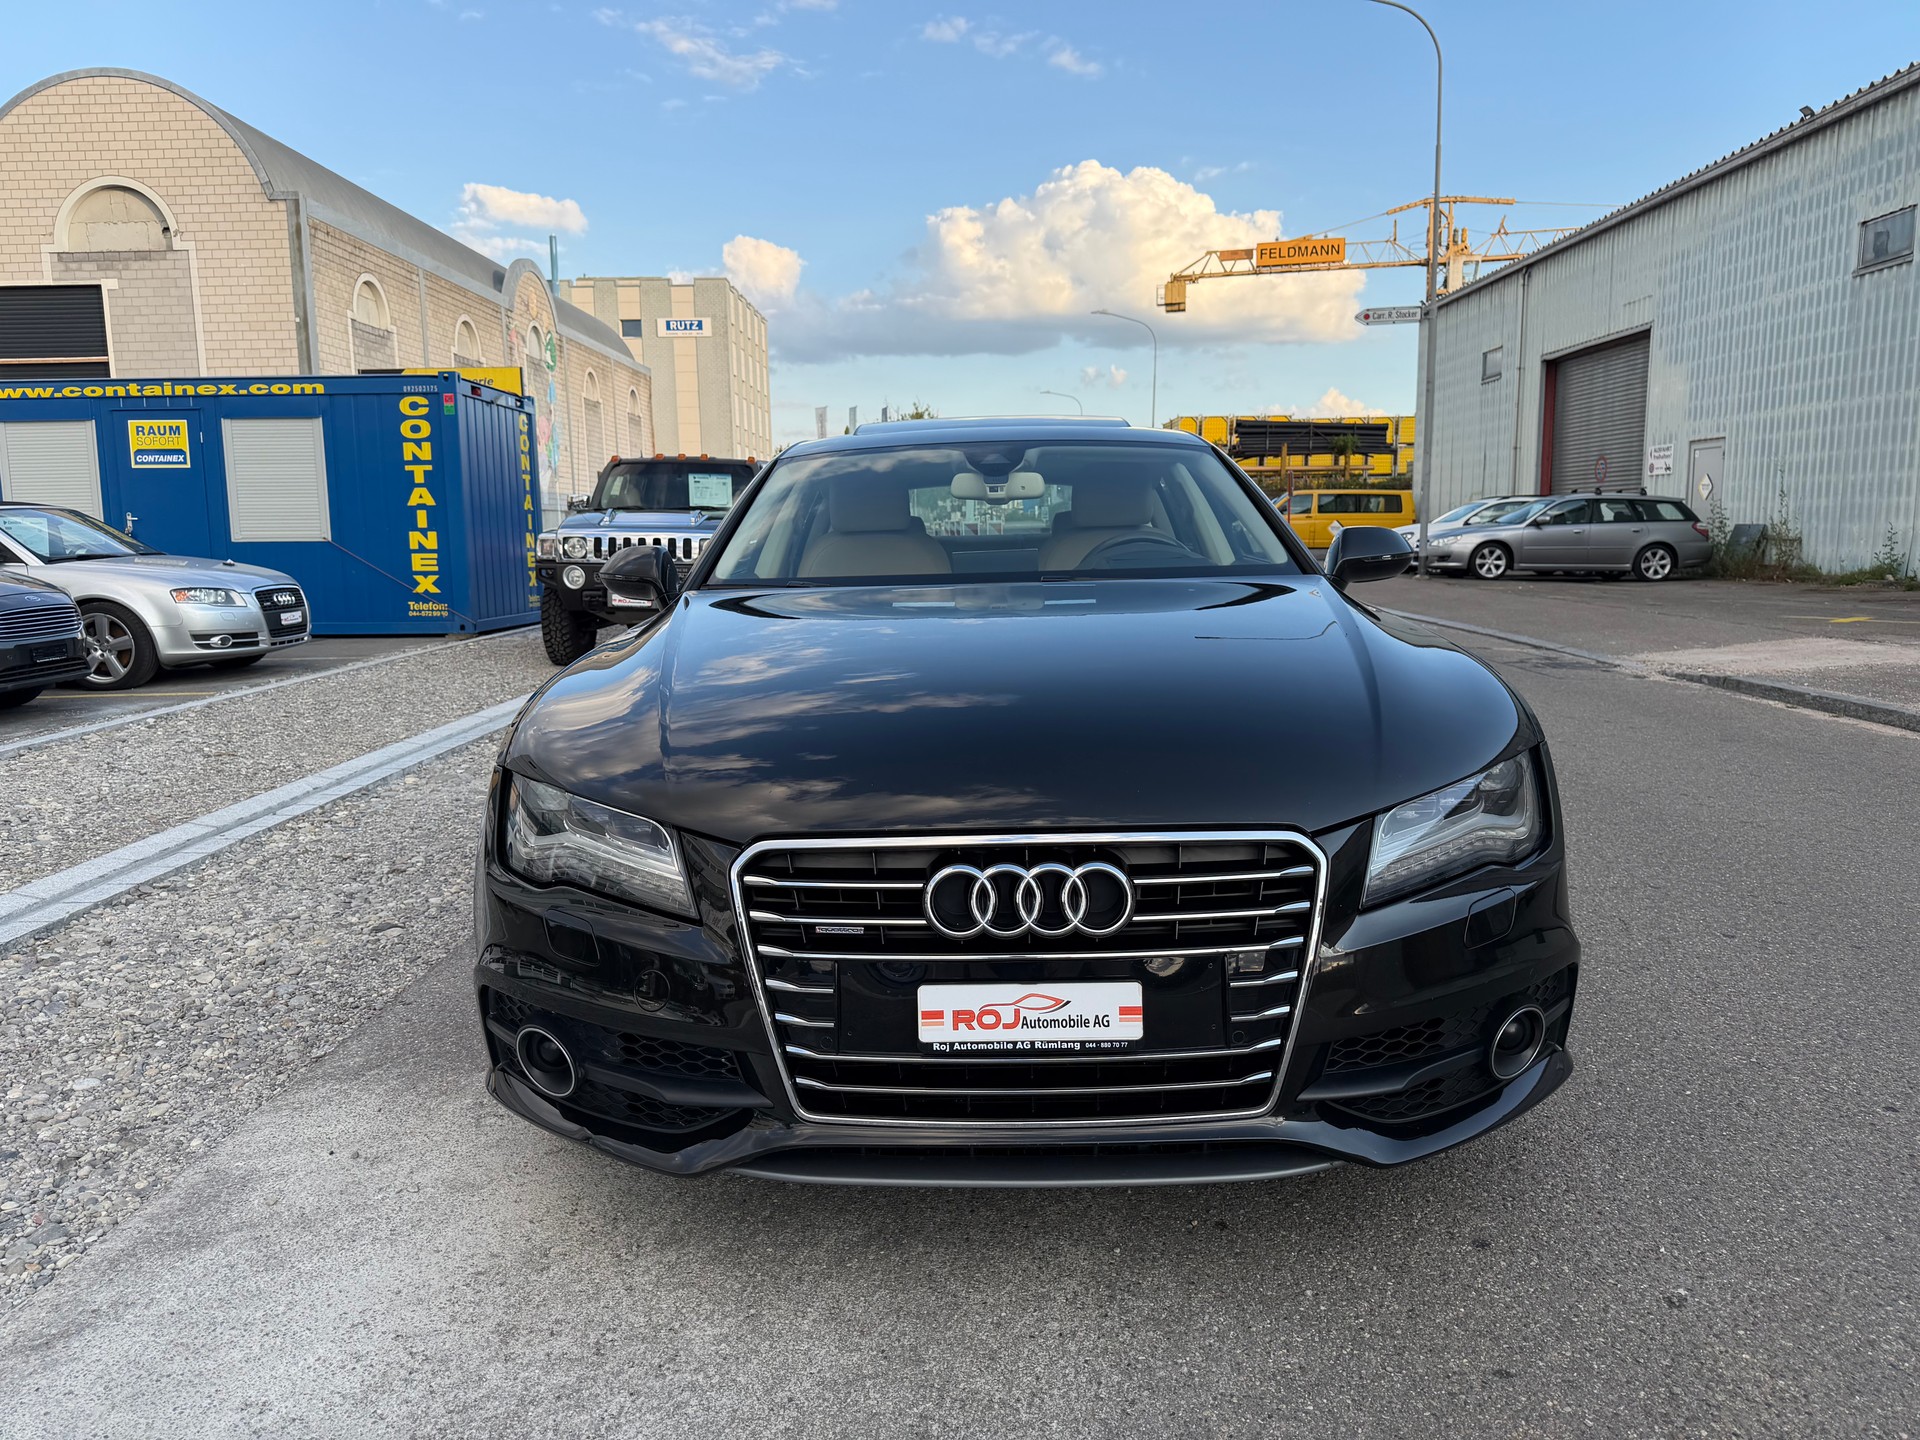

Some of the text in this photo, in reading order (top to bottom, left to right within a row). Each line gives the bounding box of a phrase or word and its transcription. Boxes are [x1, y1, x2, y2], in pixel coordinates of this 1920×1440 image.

[1260, 243, 1340, 260] FELDMANN
[670, 320, 699, 330] RUTZ
[135, 425, 181, 436] RAUM
[136, 436, 181, 446] SOFORT
[136, 454, 185, 462] CONTAINEX
[399, 396, 441, 593] CONTAINEX
[518, 414, 538, 586] CONTAINEX
[408, 601, 448, 610] Telefon:
[952, 1008, 1110, 1031] ROJ Automobile AG
[933, 1042, 949, 1052] Roj
[953, 1041, 1013, 1050] Automobile
[1016, 1041, 1031, 1049] AG
[1034, 1040, 1080, 1050] Rümlang
